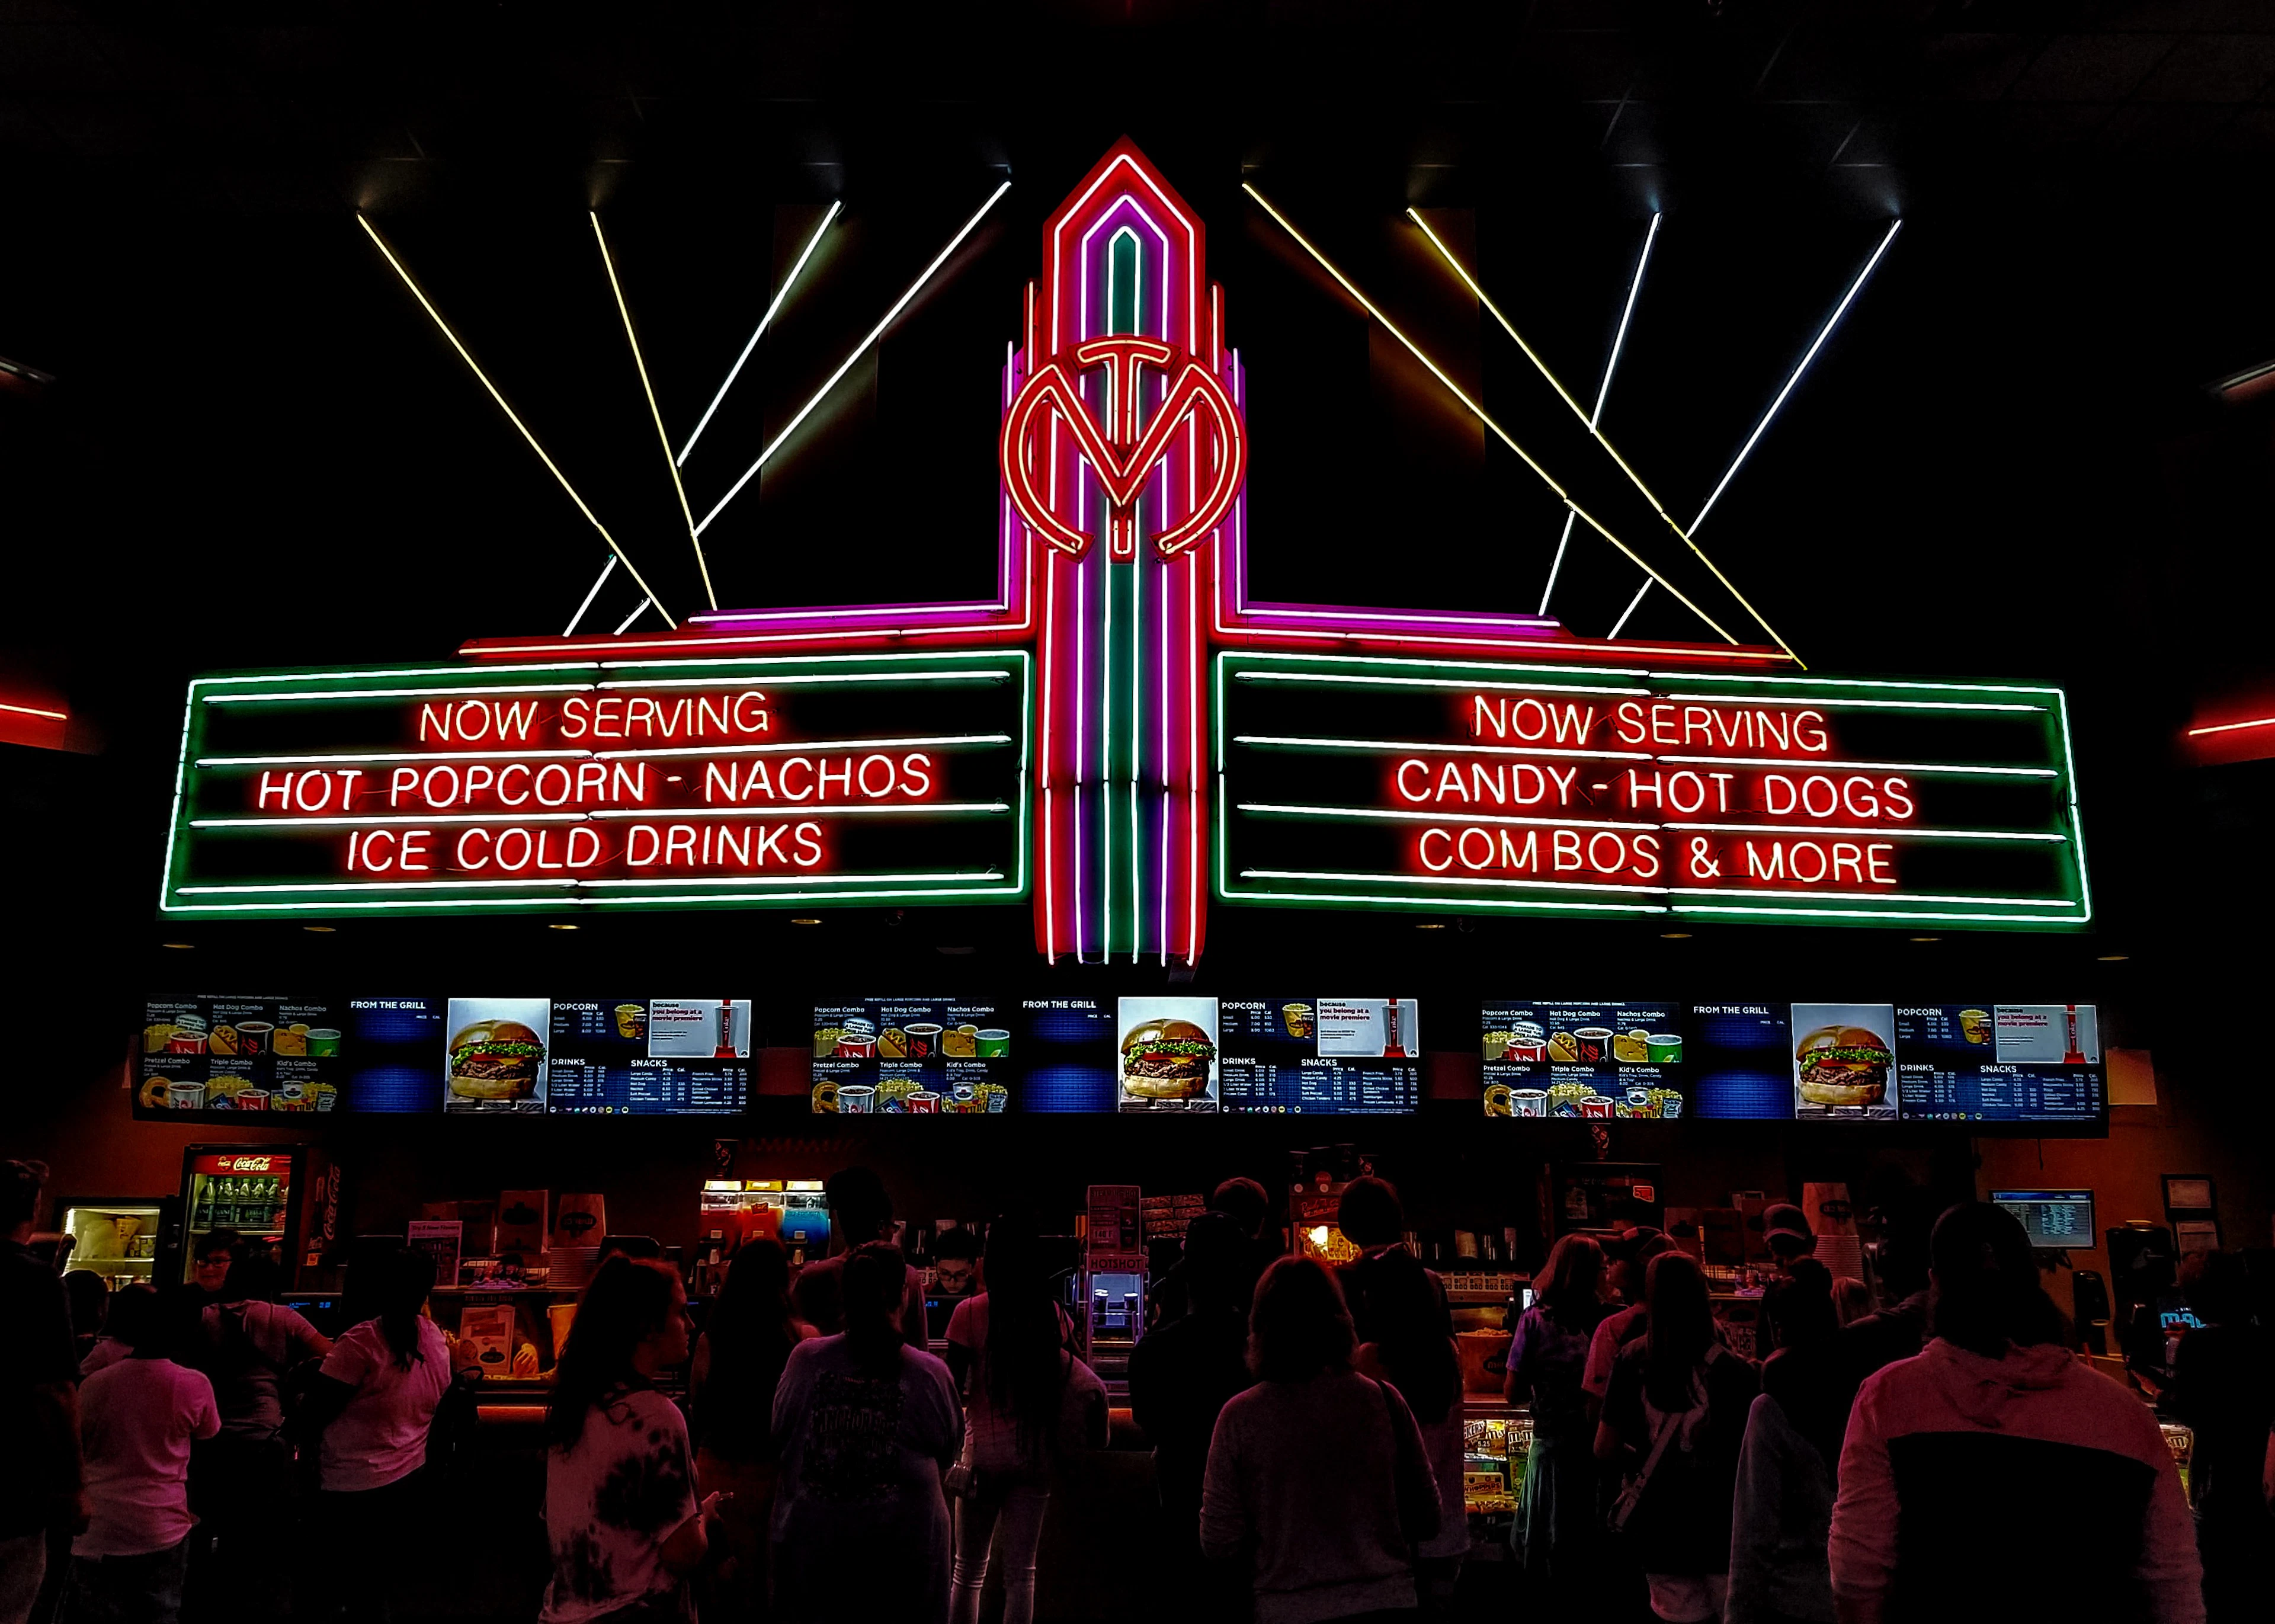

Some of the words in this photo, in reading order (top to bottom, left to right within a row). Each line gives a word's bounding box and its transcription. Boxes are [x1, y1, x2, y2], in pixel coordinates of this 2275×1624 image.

[420, 700, 539, 741] NOW
[560, 691, 768, 738] SERVING
[1475, 695, 1593, 745] NOW
[1617, 702, 1827, 751] SERVING
[259, 769, 363, 811] HOT
[391, 762, 645, 808] POPCORN
[706, 753, 931, 802] NACHOS
[1398, 759, 1577, 805] CANDY
[1628, 768, 1734, 813] HOT
[1764, 774, 1913, 819] DOGS
[347, 829, 431, 872] ICE
[457, 827, 600, 871] COLD
[627, 822, 822, 866] DRINKS
[1690, 837, 1720, 879] &
[1746, 841, 1897, 883] MORE
[1980, 1065, 2017, 1073] SNACKS
[1091, 1258, 1143, 1269] HOTSHOT
[1477, 1439, 1491, 1447] 5.25
